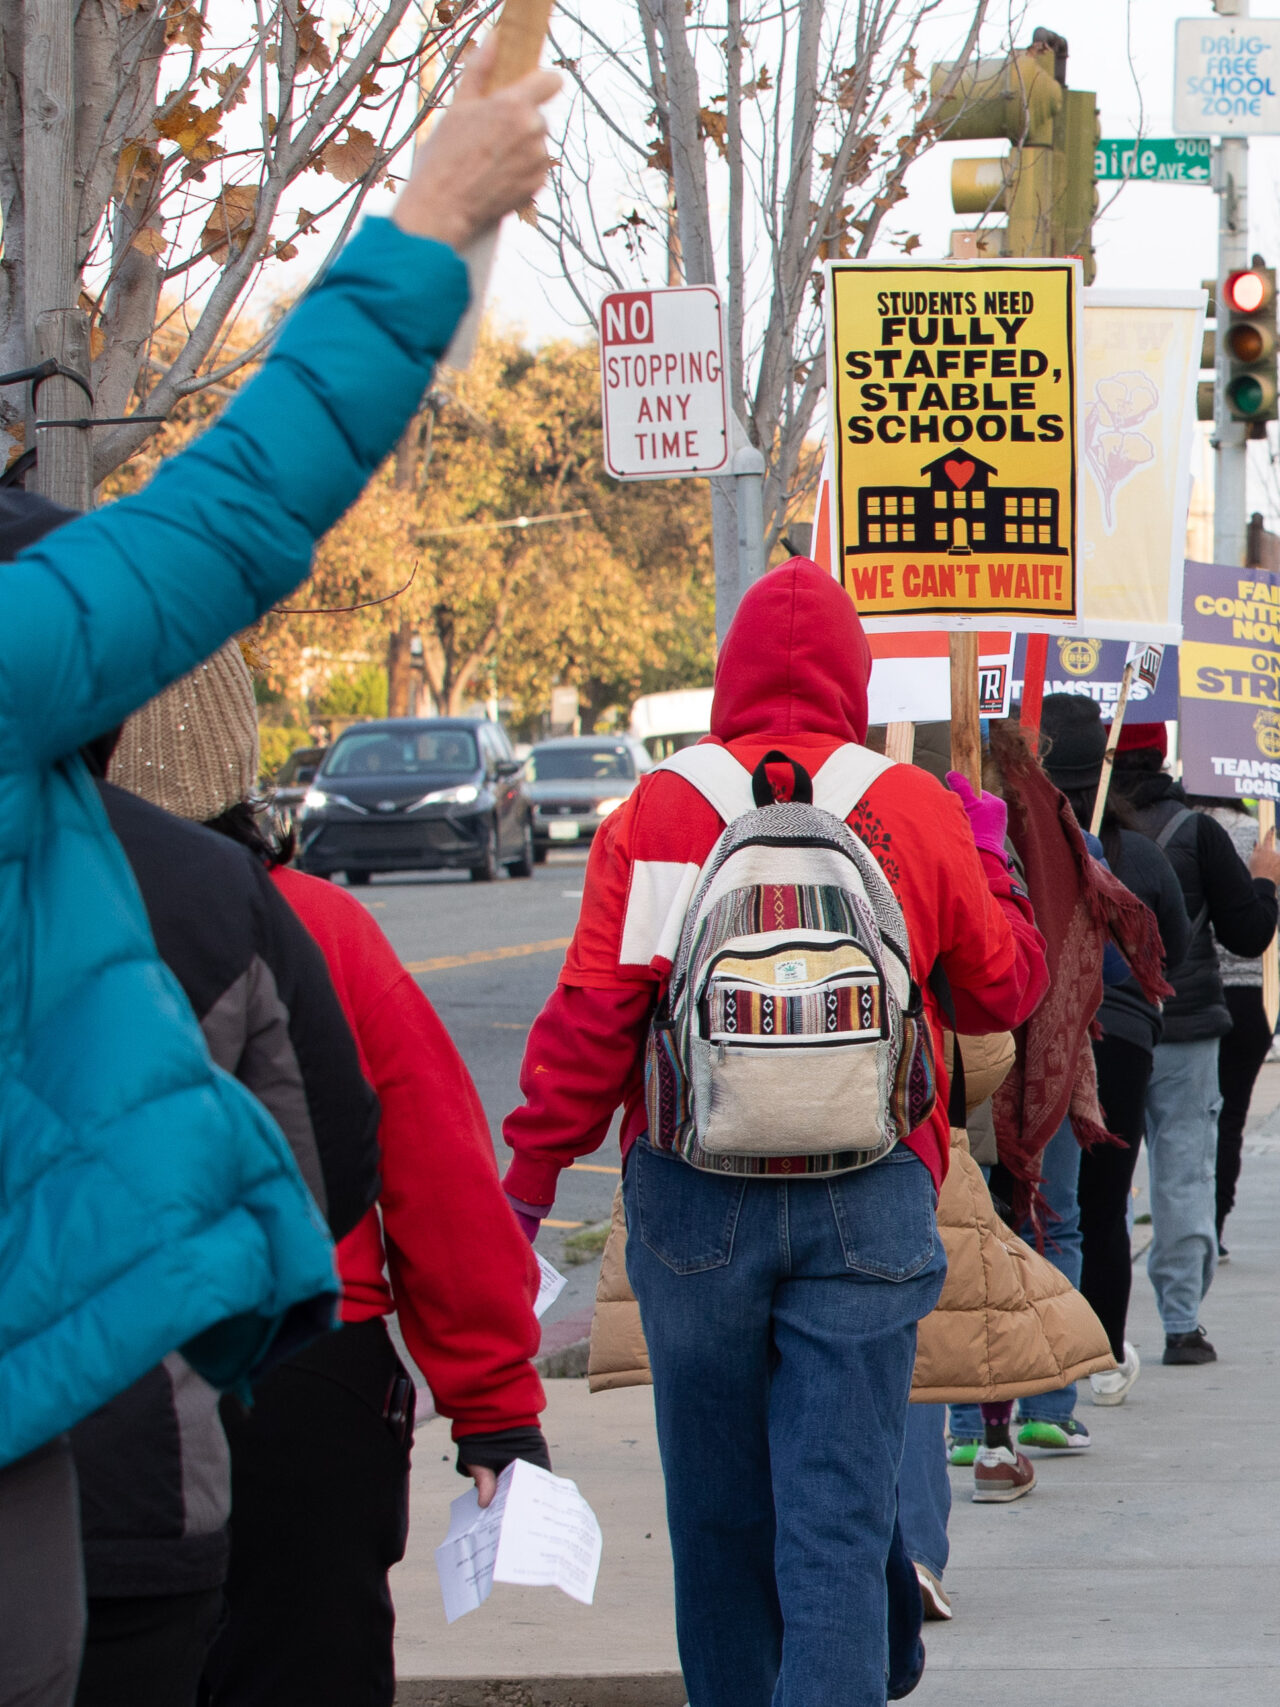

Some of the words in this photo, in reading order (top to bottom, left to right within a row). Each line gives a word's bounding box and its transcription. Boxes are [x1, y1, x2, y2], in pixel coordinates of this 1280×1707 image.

[1200, 36, 1272, 55] DRUG-
[1206, 57, 1258, 76] FREE
[1186, 77, 1276, 96] SCHOOL
[1201, 97, 1262, 117] ZONE
[1175, 140, 1210, 157] 900
[1156, 163, 1187, 180] AVE
[877, 291, 977, 317] STUDENTS
[984, 291, 1034, 316] NEED
[605, 300, 651, 342] NO
[881, 317, 1028, 346] FULLY
[608, 350, 721, 389] STOPPING
[845, 349, 1062, 384] STAFFED,
[637, 393, 692, 424] ANY
[860, 382, 1037, 412] STABLE
[848, 414, 1064, 444] SCHOOLS
[634, 430, 699, 461] TIME
[851, 564, 895, 601] WE
[902, 564, 981, 598] CAN'T
[988, 563, 1064, 601] WAIT!
[1234, 778, 1280, 798] LOCAL
